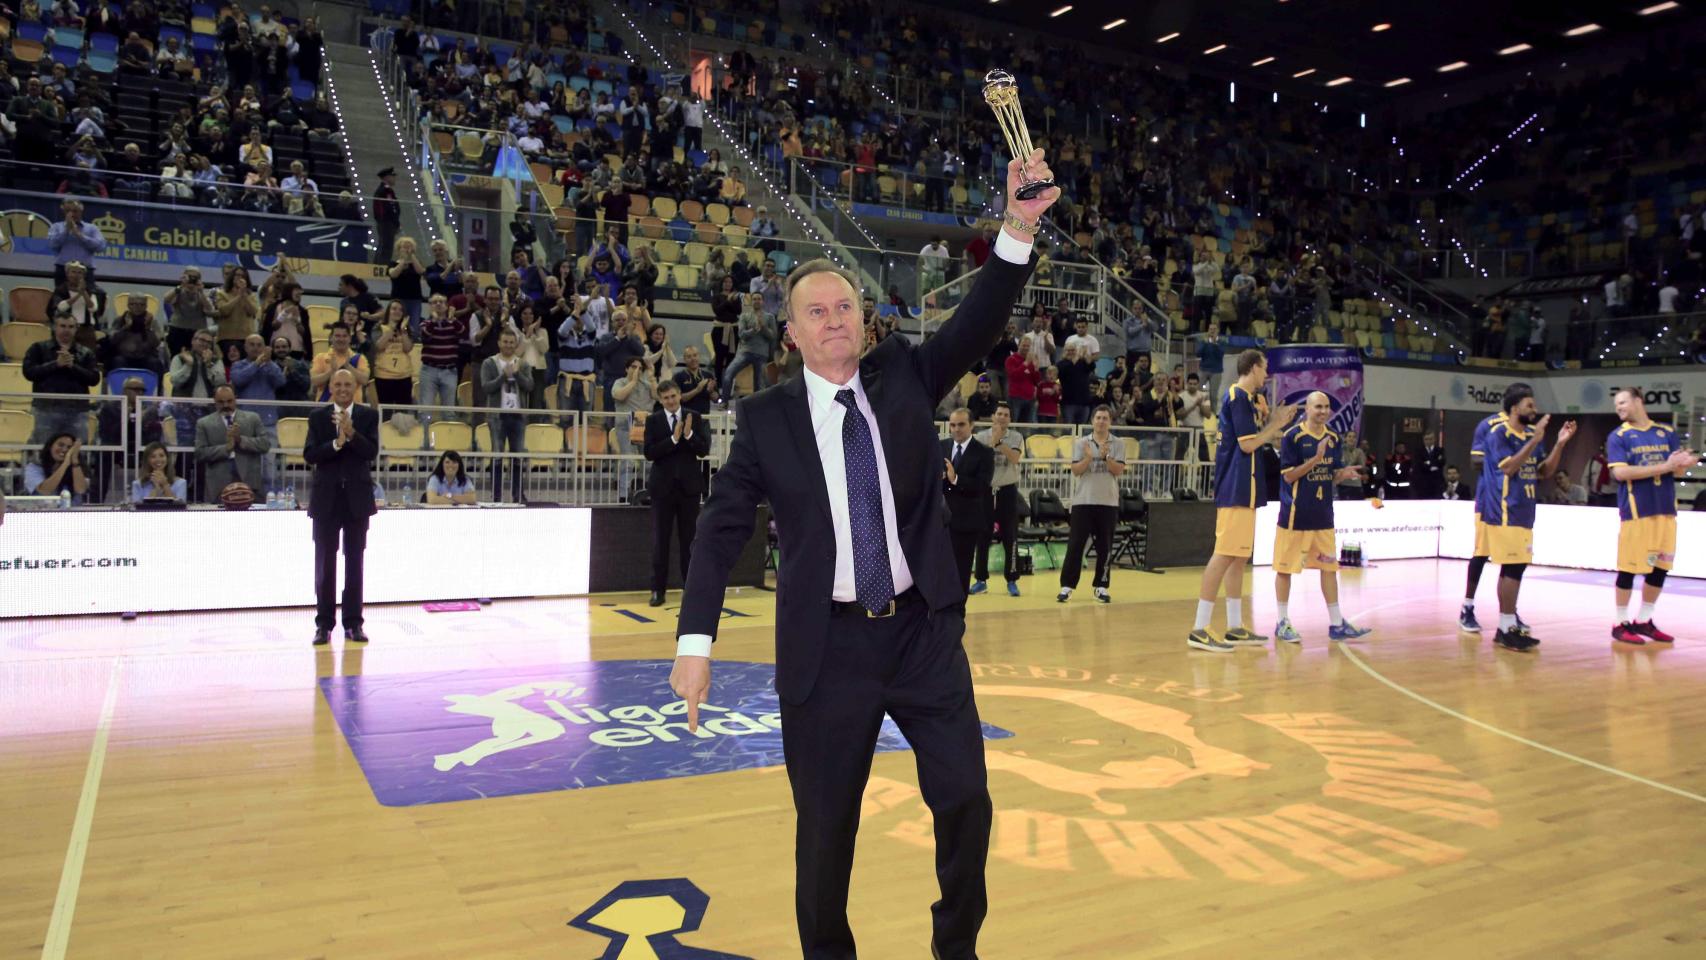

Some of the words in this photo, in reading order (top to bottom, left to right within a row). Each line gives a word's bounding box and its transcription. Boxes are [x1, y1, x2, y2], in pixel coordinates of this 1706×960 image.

[144, 226, 232, 250] Cabildo
[236, 234, 263, 252] de
[95, 246, 119, 258] RAN
[124, 247, 169, 262] CANARIA
[373, 267, 389, 277] GR
[392, 357, 398, 368] 7
[1316, 485, 1323, 500] 4
[1524, 484, 1536, 498] 11
[545, 699, 730, 726] liga
